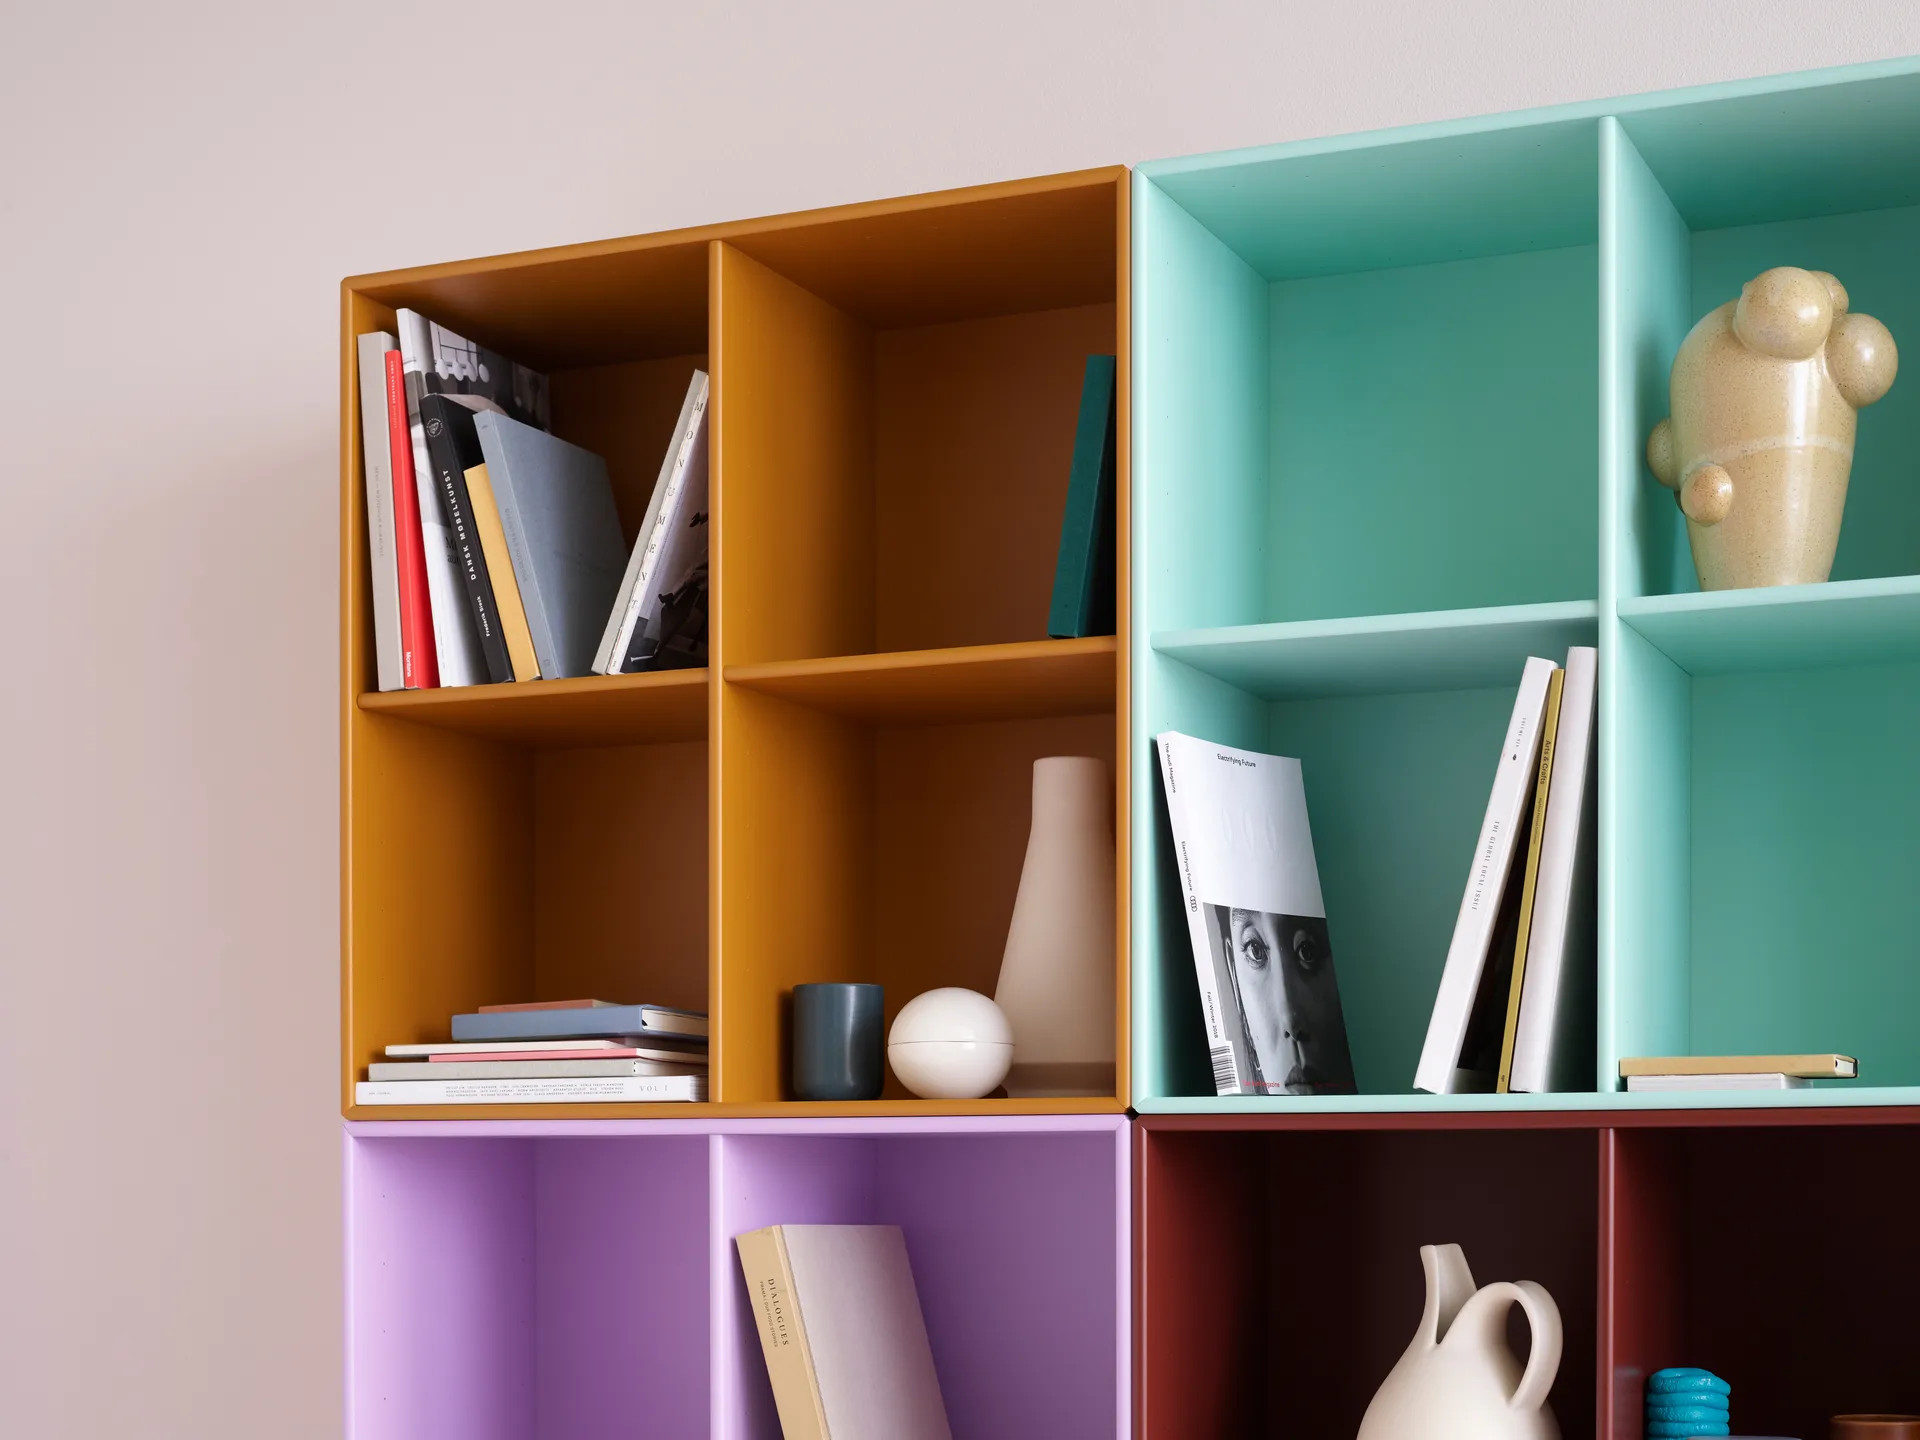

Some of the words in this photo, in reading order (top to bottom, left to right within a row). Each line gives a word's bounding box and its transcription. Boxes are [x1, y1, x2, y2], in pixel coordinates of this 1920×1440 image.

[463, 546, 476, 580] DANSK
[1217, 753, 1241, 766] Electrifying
[1242, 759, 1256, 767] Future
[1540, 763, 1548, 784] Crafts
[1207, 992, 1215, 1023] Fall/Winter
[768, 1279, 788, 1345] DIALOGUES
